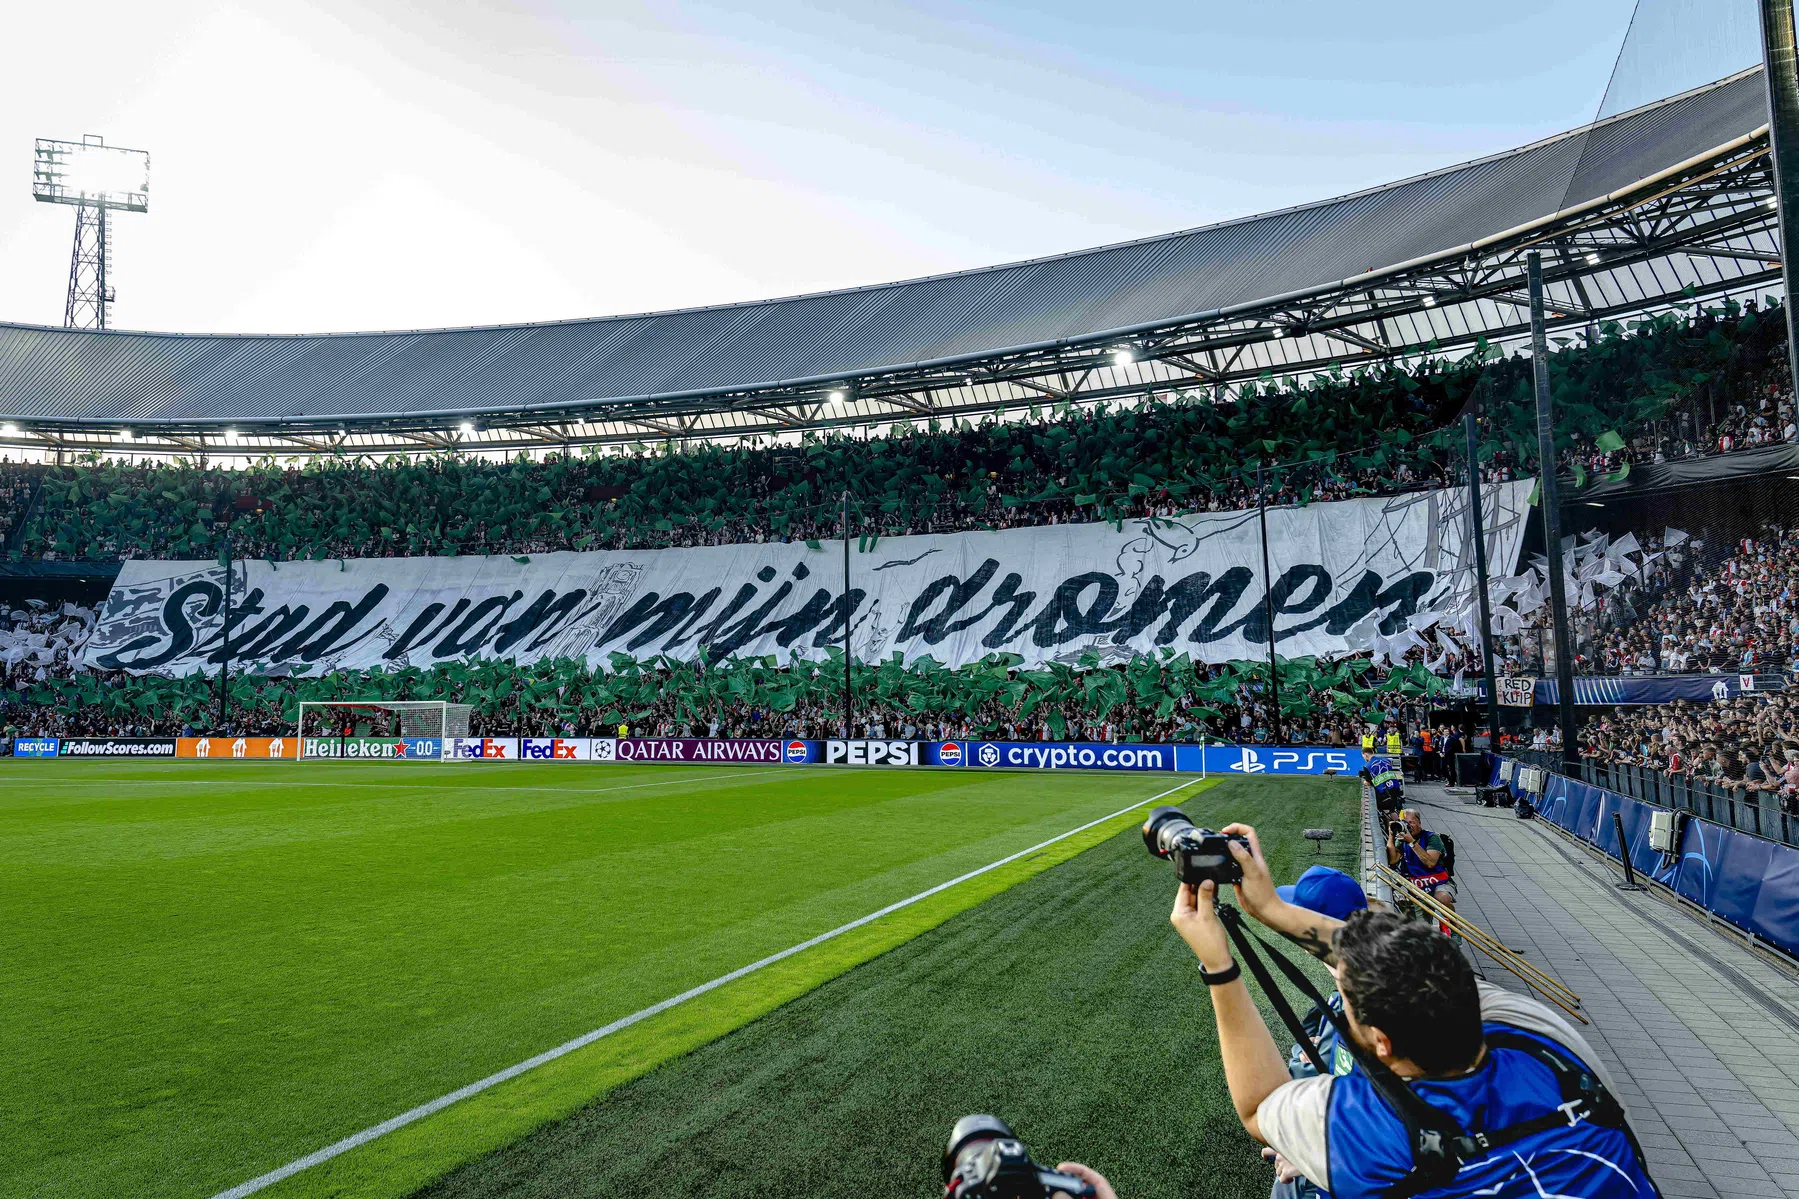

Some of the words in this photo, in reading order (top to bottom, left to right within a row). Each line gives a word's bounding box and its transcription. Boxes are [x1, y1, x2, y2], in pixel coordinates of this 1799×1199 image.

[95, 580, 388, 670] Stad
[382, 589, 600, 660] van
[598, 561, 879, 664] mijn
[896, 557, 1451, 648] dromen
[1504, 678, 1532, 691] RED
[18, 742, 54, 752] RECYCLE
[67, 741, 174, 755] FollowScores.com
[305, 738, 394, 757] Heineken
[453, 738, 506, 759] FedEx
[522, 738, 577, 759] FedEx
[618, 741, 685, 761] QATAR
[692, 740, 780, 761] AIRWAYS
[826, 741, 919, 766] PEPSI
[1008, 745, 1163, 769] crypto.com
[1272, 752, 1348, 771] PS5
